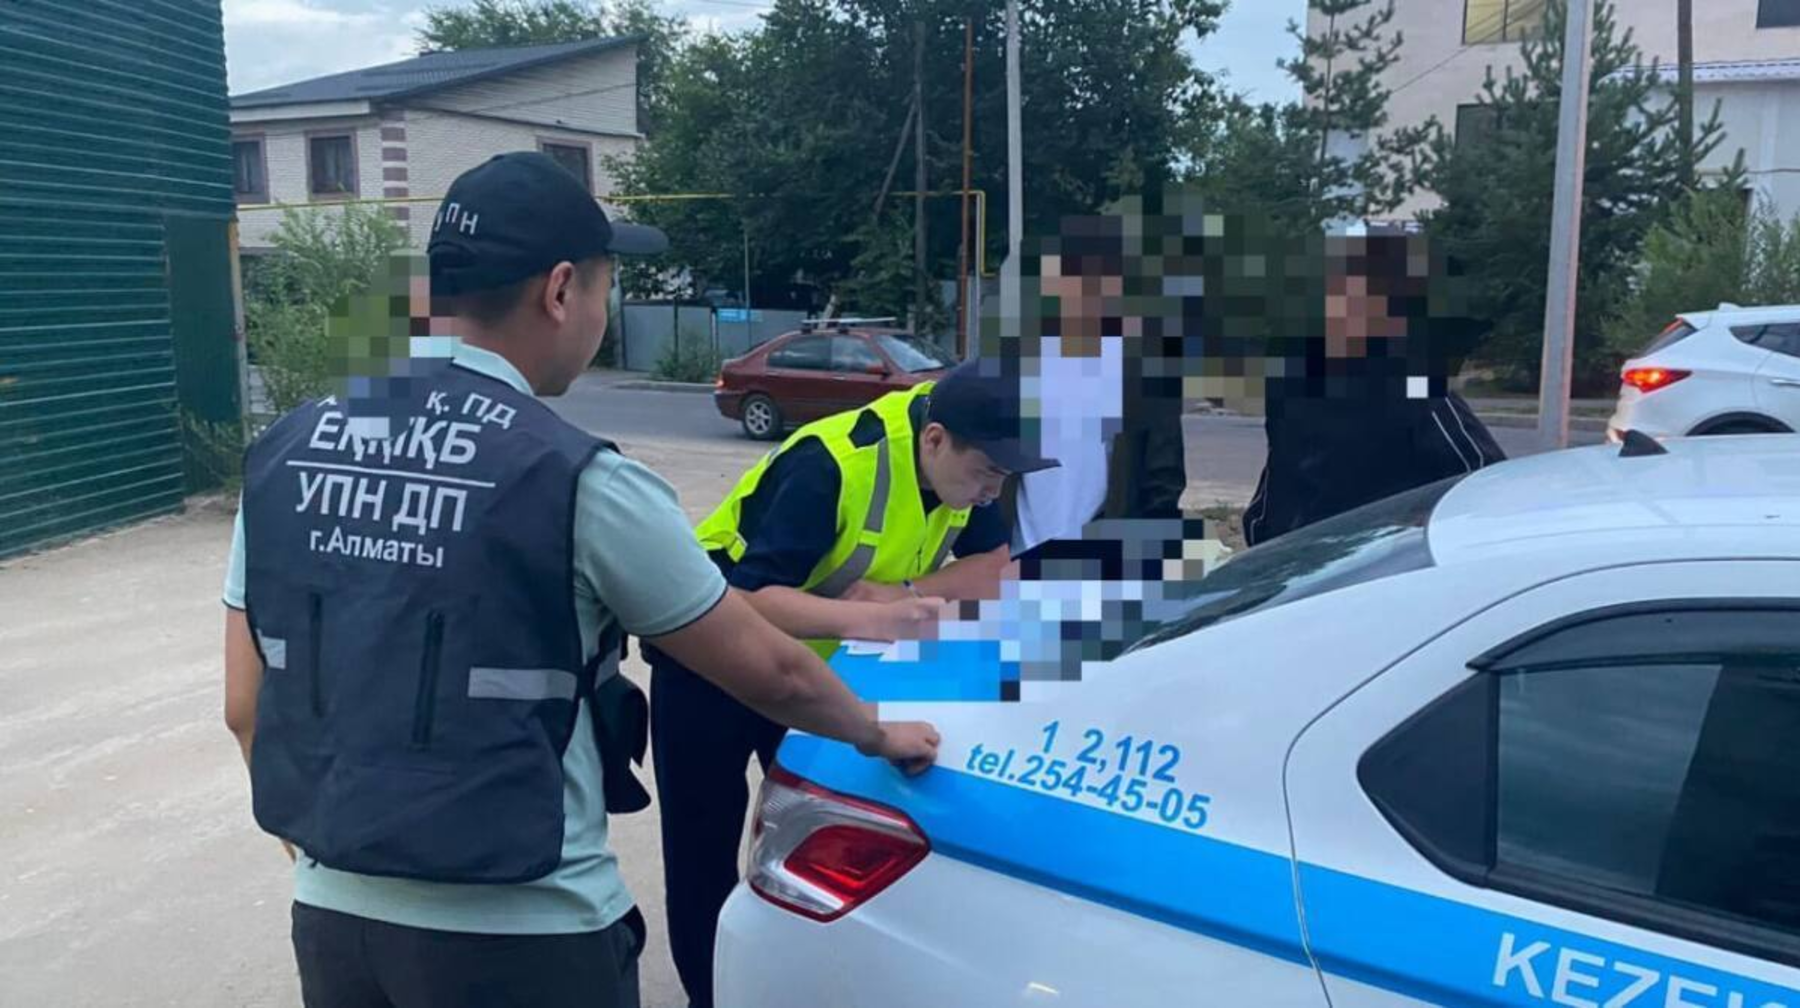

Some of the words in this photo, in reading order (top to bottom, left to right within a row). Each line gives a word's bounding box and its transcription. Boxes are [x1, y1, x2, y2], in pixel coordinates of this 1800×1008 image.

[461, 392, 517, 429] ПД
[296, 472, 386, 522] УПН
[393, 483, 467, 534] ДП
[309, 527, 444, 567] г.Алматы
[966, 743, 1211, 829] tel.254-45-05
